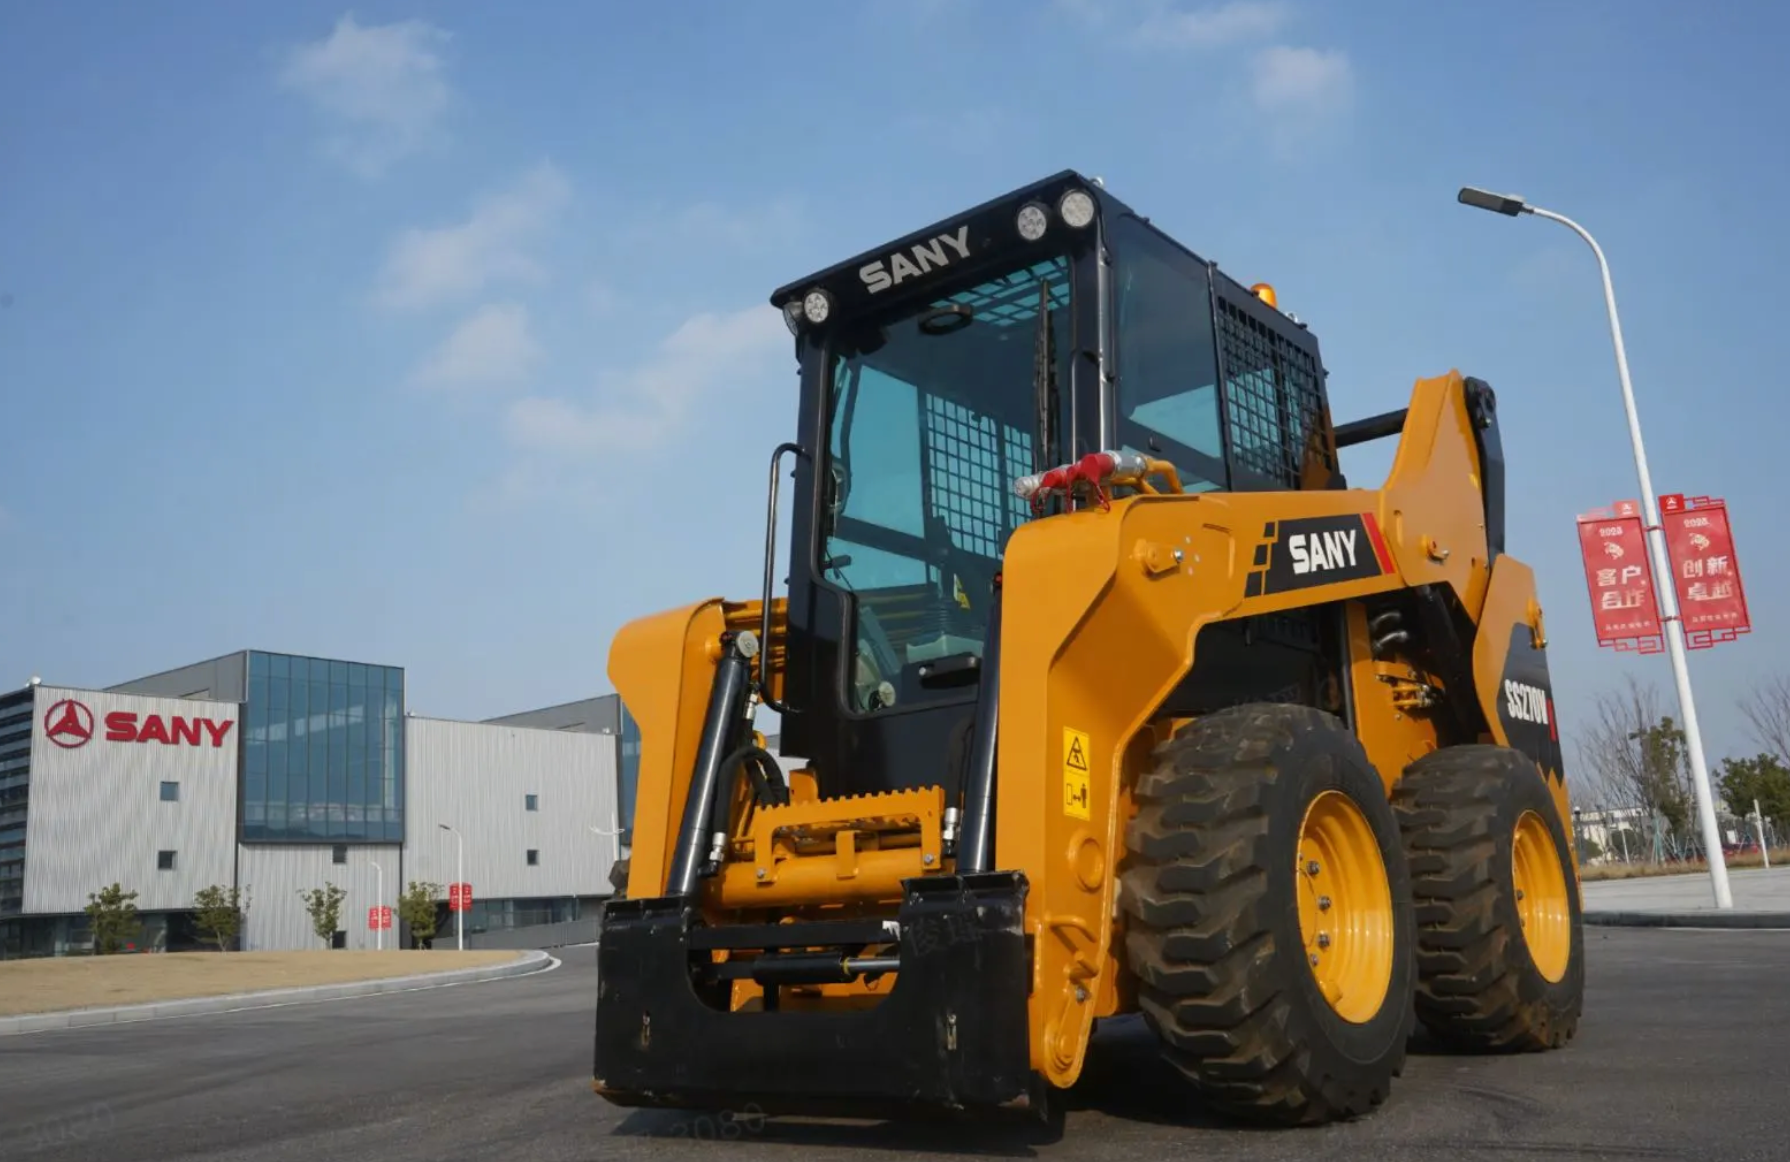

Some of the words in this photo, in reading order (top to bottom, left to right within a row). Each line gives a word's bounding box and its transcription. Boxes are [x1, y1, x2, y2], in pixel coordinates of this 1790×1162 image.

[859, 225, 971, 294] SANY
[1289, 529, 1357, 575] SANY
[105, 711, 234, 747] SANY
